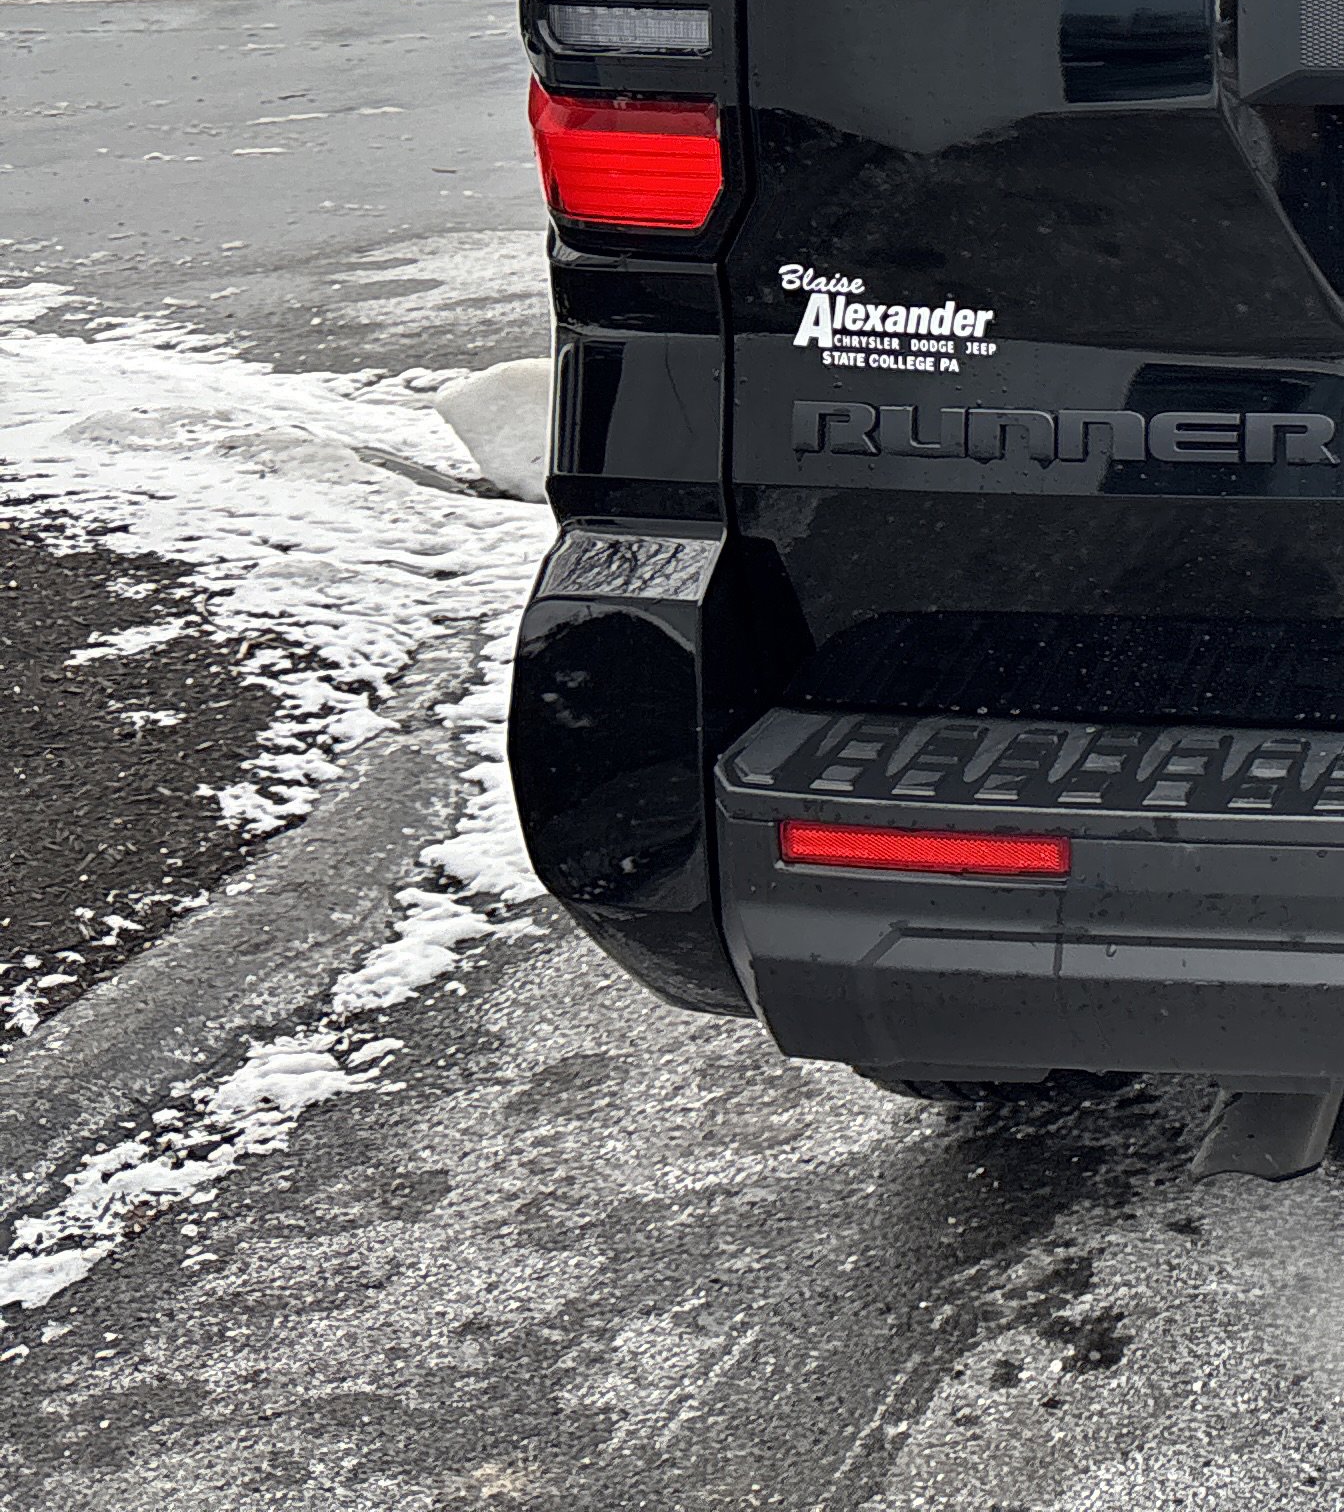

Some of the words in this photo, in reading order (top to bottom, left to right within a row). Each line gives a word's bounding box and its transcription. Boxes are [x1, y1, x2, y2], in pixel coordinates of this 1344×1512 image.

[778, 264, 865, 293] Blaise
[793, 292, 994, 348] Alexander
[833, 335, 900, 350] CHRYSLER
[910, 338, 955, 354] DODGE
[965, 341, 997, 356] JEEP
[822, 350, 866, 367] STATE
[868, 354, 935, 371] COLLEGE
[939, 357, 960, 373] PA
[793, 399, 1342, 466] RUNNER
